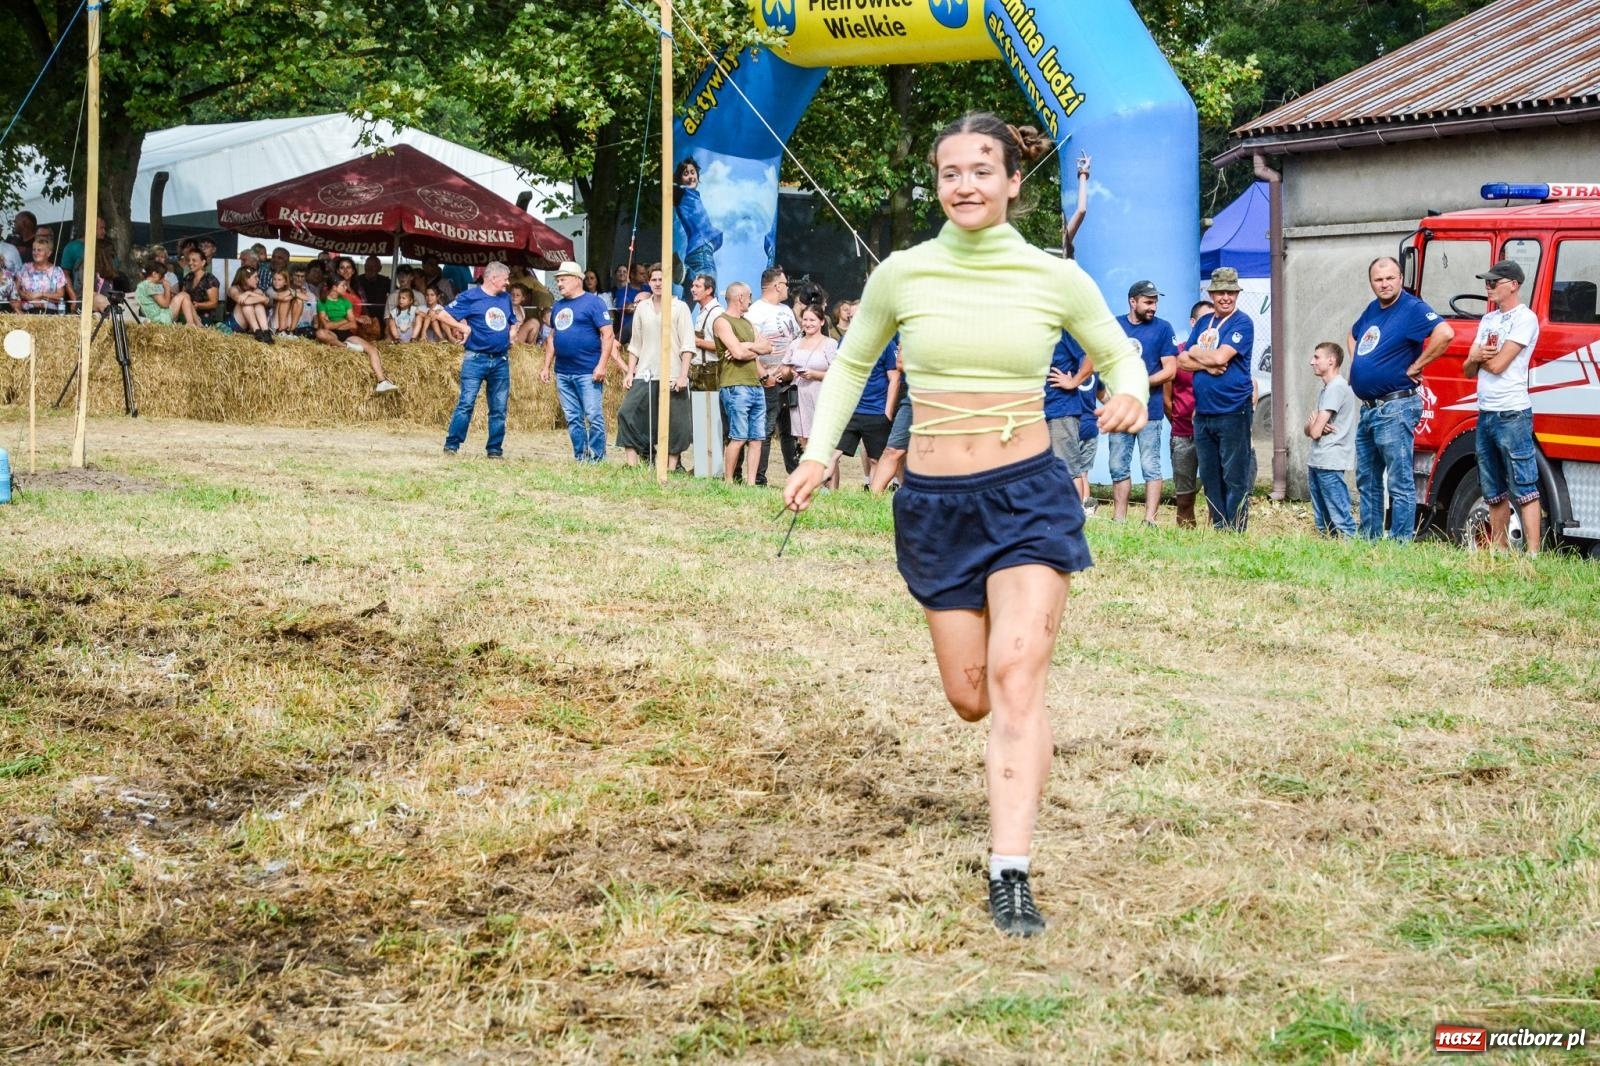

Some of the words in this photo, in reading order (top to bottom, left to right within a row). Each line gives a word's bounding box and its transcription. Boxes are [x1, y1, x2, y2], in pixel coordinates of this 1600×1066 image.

[823, 14, 907, 39] Wielkie
[1001, 0, 1045, 57] mina
[1037, 45, 1087, 117] ludzi
[988, 11, 1059, 139] aktywnych
[1551, 185, 1600, 197] STRA
[279, 206, 384, 227] RACIBORSKIE
[414, 215, 514, 243] RACIBORSKIE
